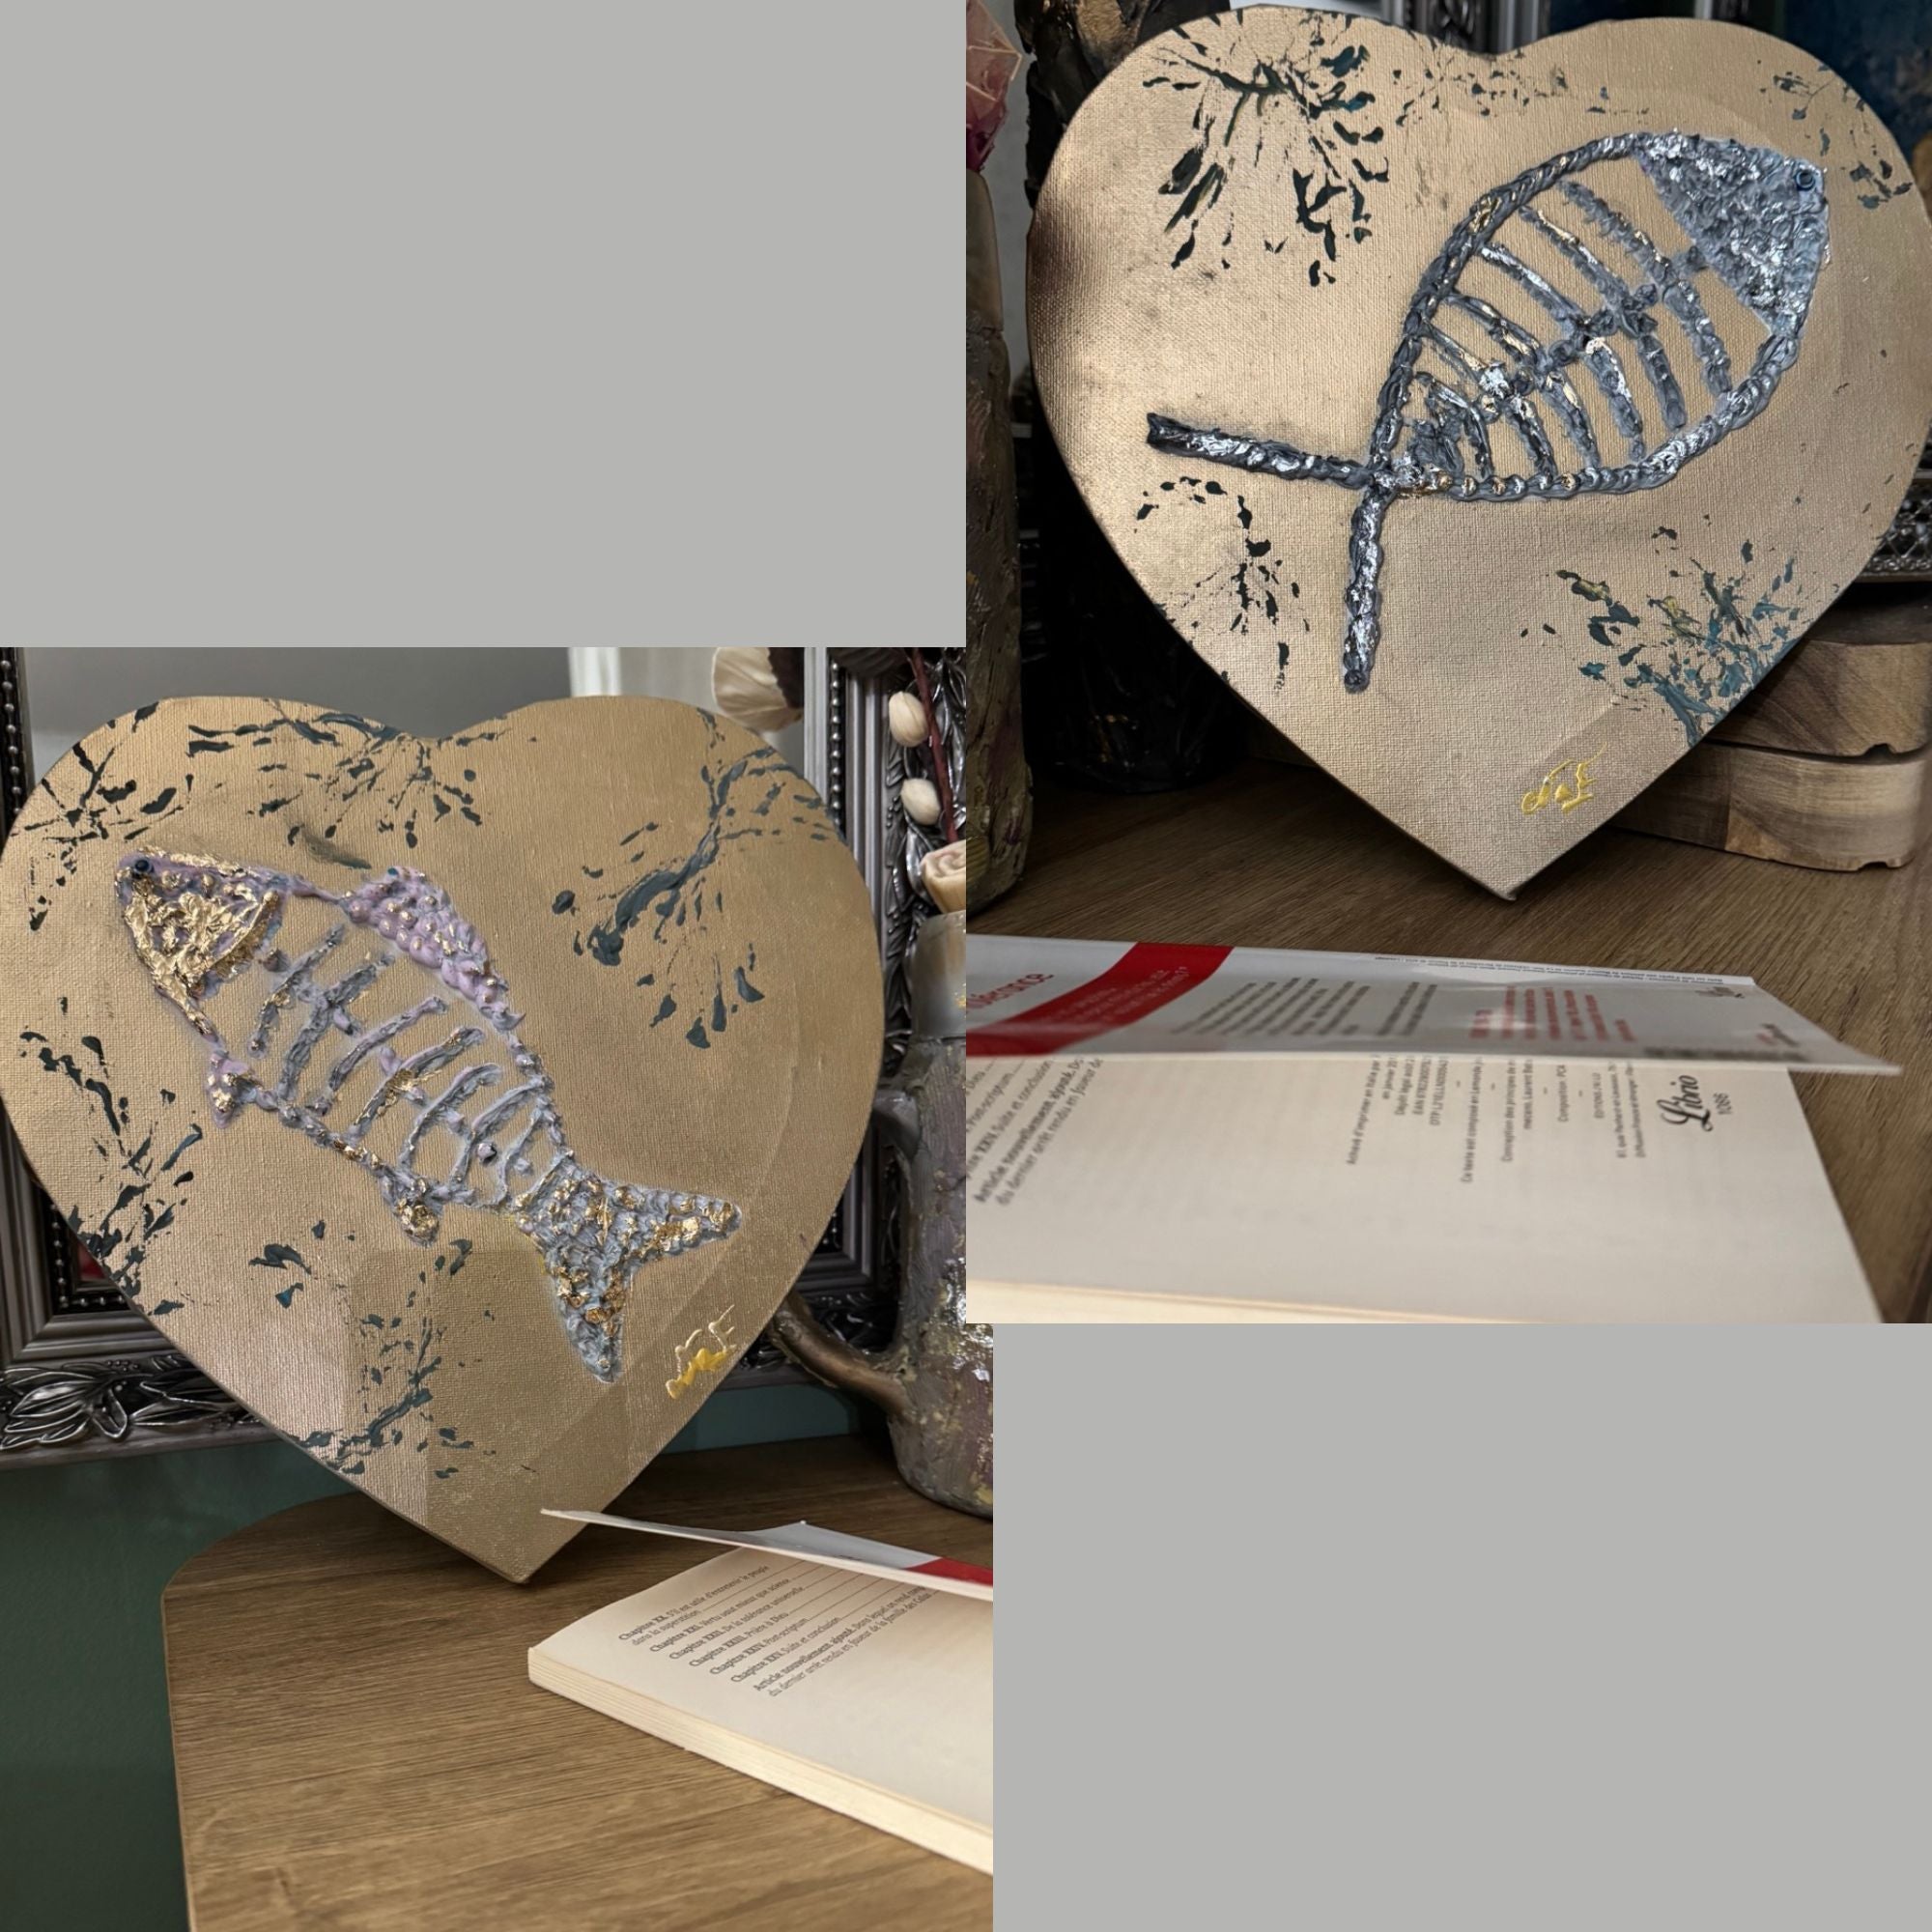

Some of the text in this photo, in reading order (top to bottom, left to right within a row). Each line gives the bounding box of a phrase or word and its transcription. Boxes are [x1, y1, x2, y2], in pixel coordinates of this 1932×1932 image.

[1656, 1075, 1713, 1132] Librio
[618, 1621, 656, 1640] Chapitre
[649, 1633, 688, 1652] Chapitre
[668, 1639, 707, 1660] Chapitre
[689, 1646, 727, 1666] Chapitre
[709, 1654, 748, 1674] Chapitre
[730, 1662, 769, 1682] Chapitre
[753, 1672, 784, 1691] Article
[781, 1642, 834, 1674] nouvellement
